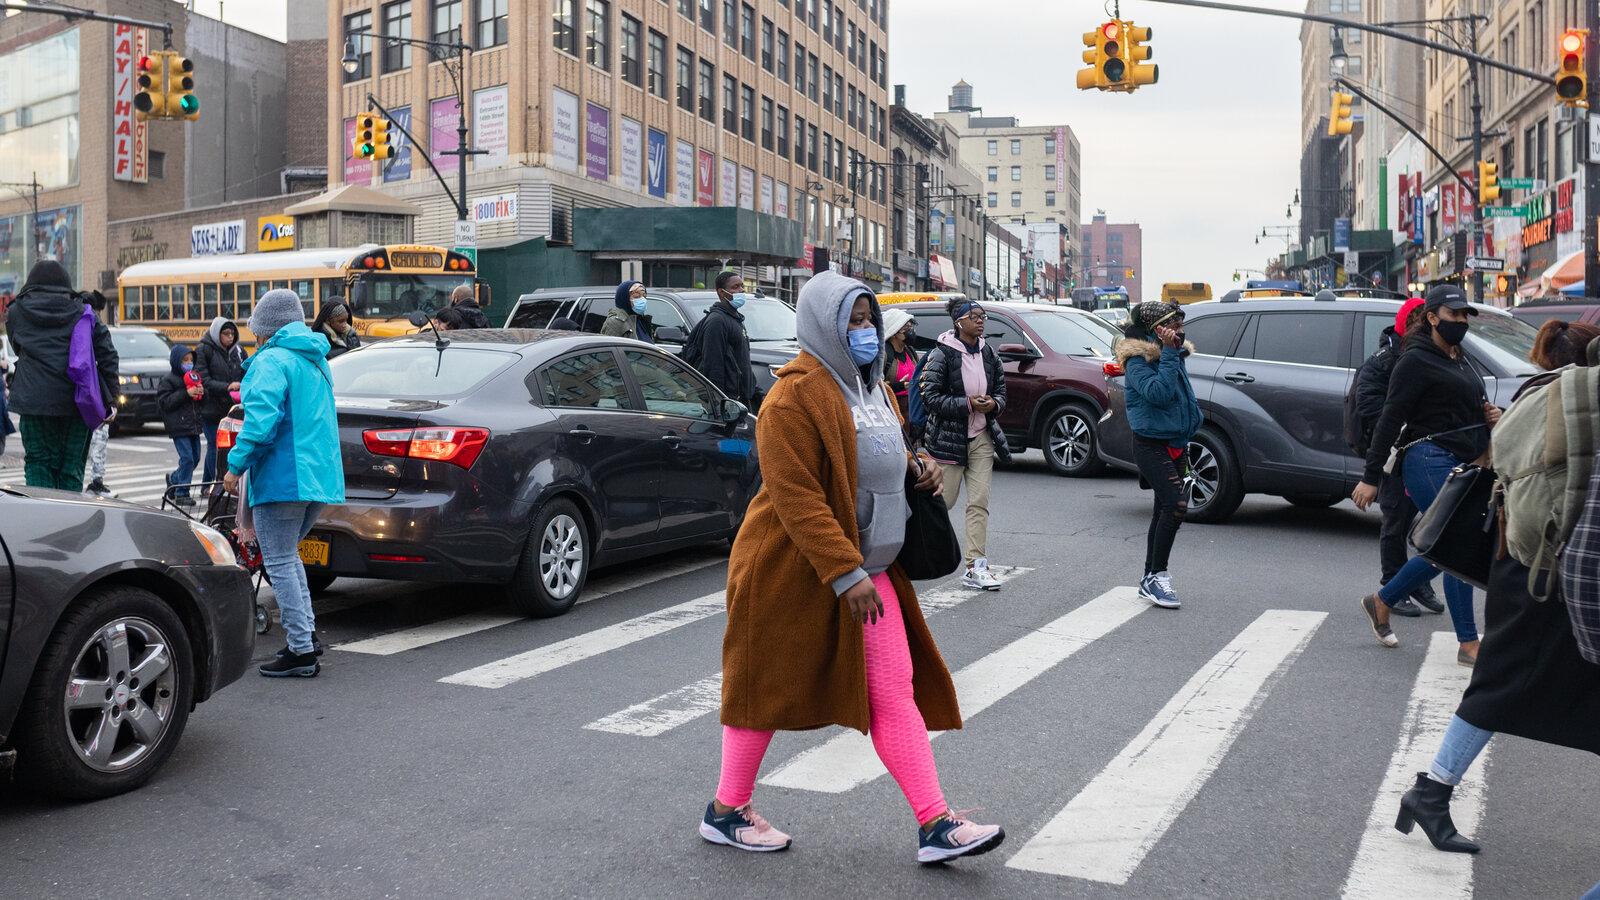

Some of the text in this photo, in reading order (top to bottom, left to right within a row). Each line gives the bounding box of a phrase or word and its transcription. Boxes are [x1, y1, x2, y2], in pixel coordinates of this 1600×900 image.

[1491, 207, 1514, 216] Melrose
[460, 225, 470, 233] NO
[456, 235, 475, 243] TURNS
[391, 252, 424, 267] SCHOOL
[304, 542, 326, 560] 8837
